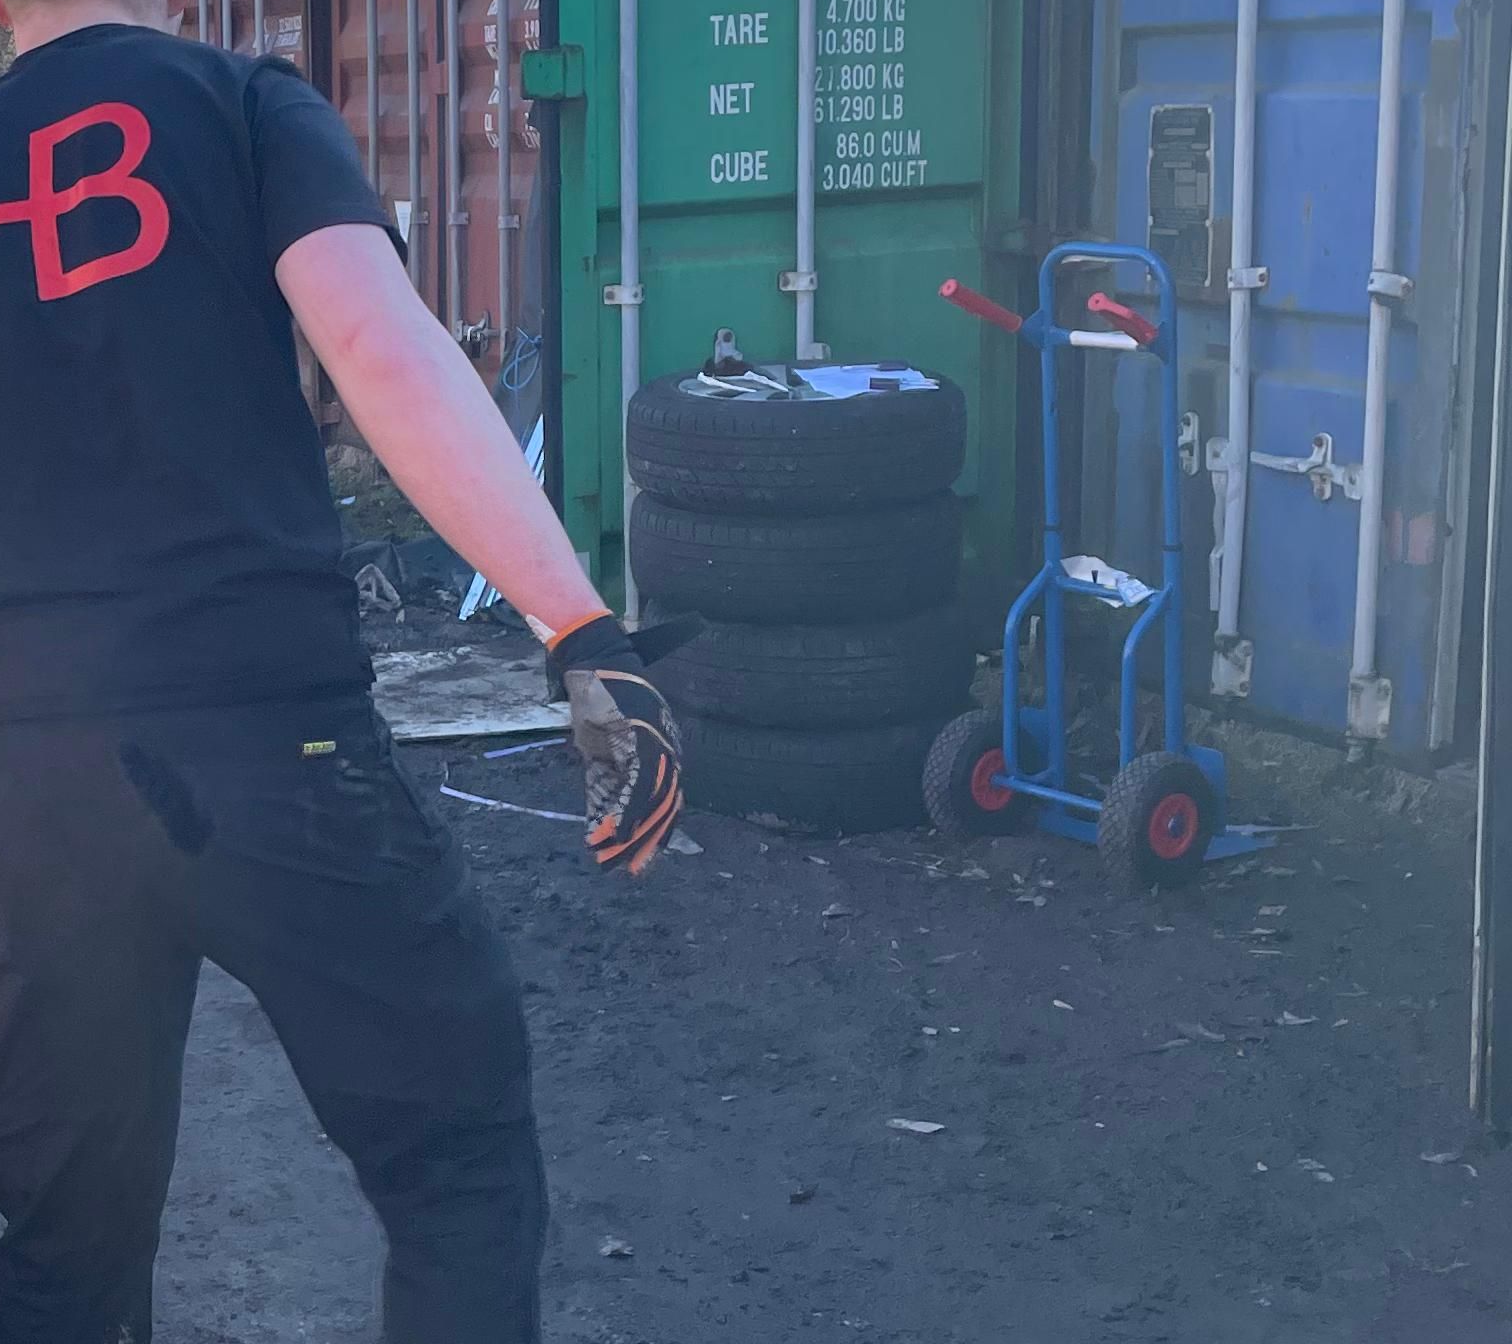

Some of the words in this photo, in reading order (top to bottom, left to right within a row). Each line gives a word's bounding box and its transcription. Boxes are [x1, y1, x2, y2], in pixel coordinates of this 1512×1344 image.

[709, 12, 769, 46] TARE
[816, 27, 876, 56] 10.360
[882, 26, 904, 53] LB
[882, 62, 905, 89] KG
[709, 82, 755, 116] NET
[814, 95, 875, 123] 61.290
[881, 94, 903, 120] LB
[836, 131, 875, 158] 86.0
[881, 129, 921, 157] CU.M
[709, 150, 769, 184] CUBE
[822, 162, 874, 190] 3.040
[881, 159, 928, 188] CU.FT
